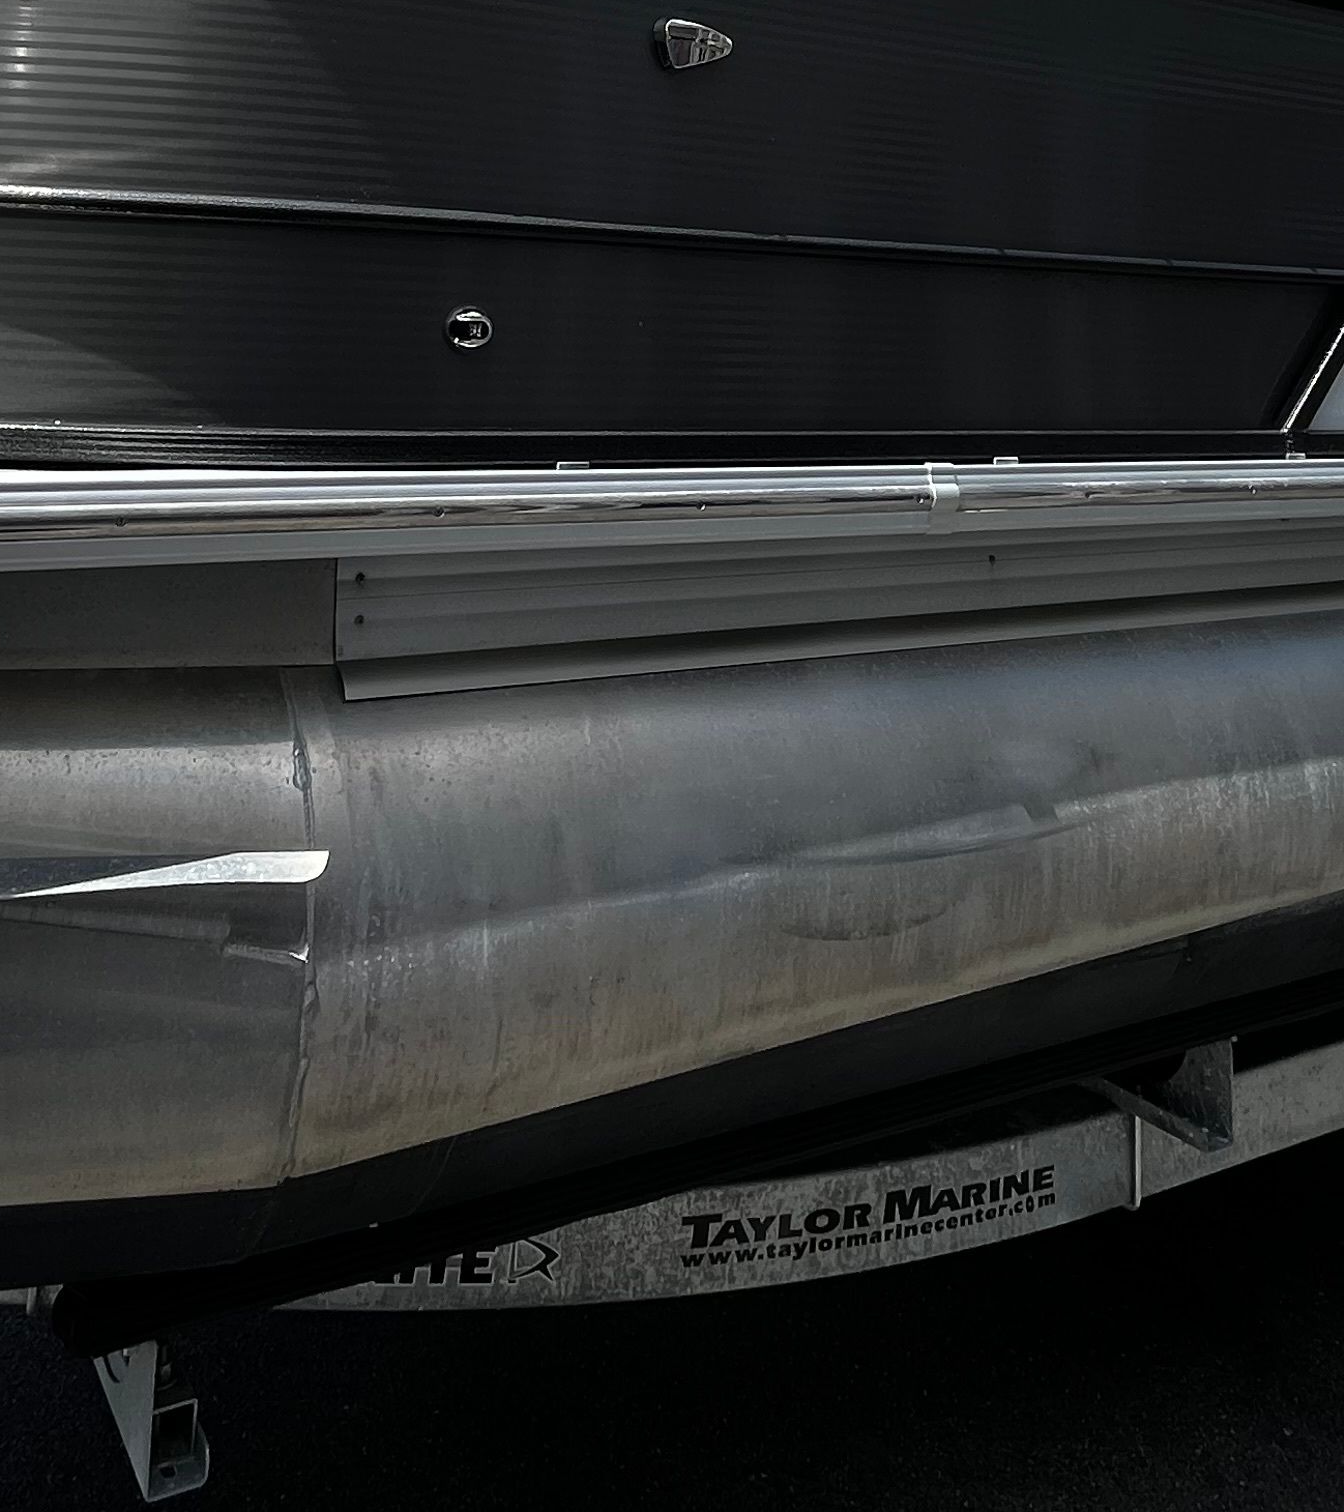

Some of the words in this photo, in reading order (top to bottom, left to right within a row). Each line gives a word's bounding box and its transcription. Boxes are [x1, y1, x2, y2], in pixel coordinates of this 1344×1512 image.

[680, 1191, 1057, 1268] www.taylormarinecenter.com
[681, 1203, 873, 1249] TAYLOR
[883, 1164, 1055, 1224] MARINE
